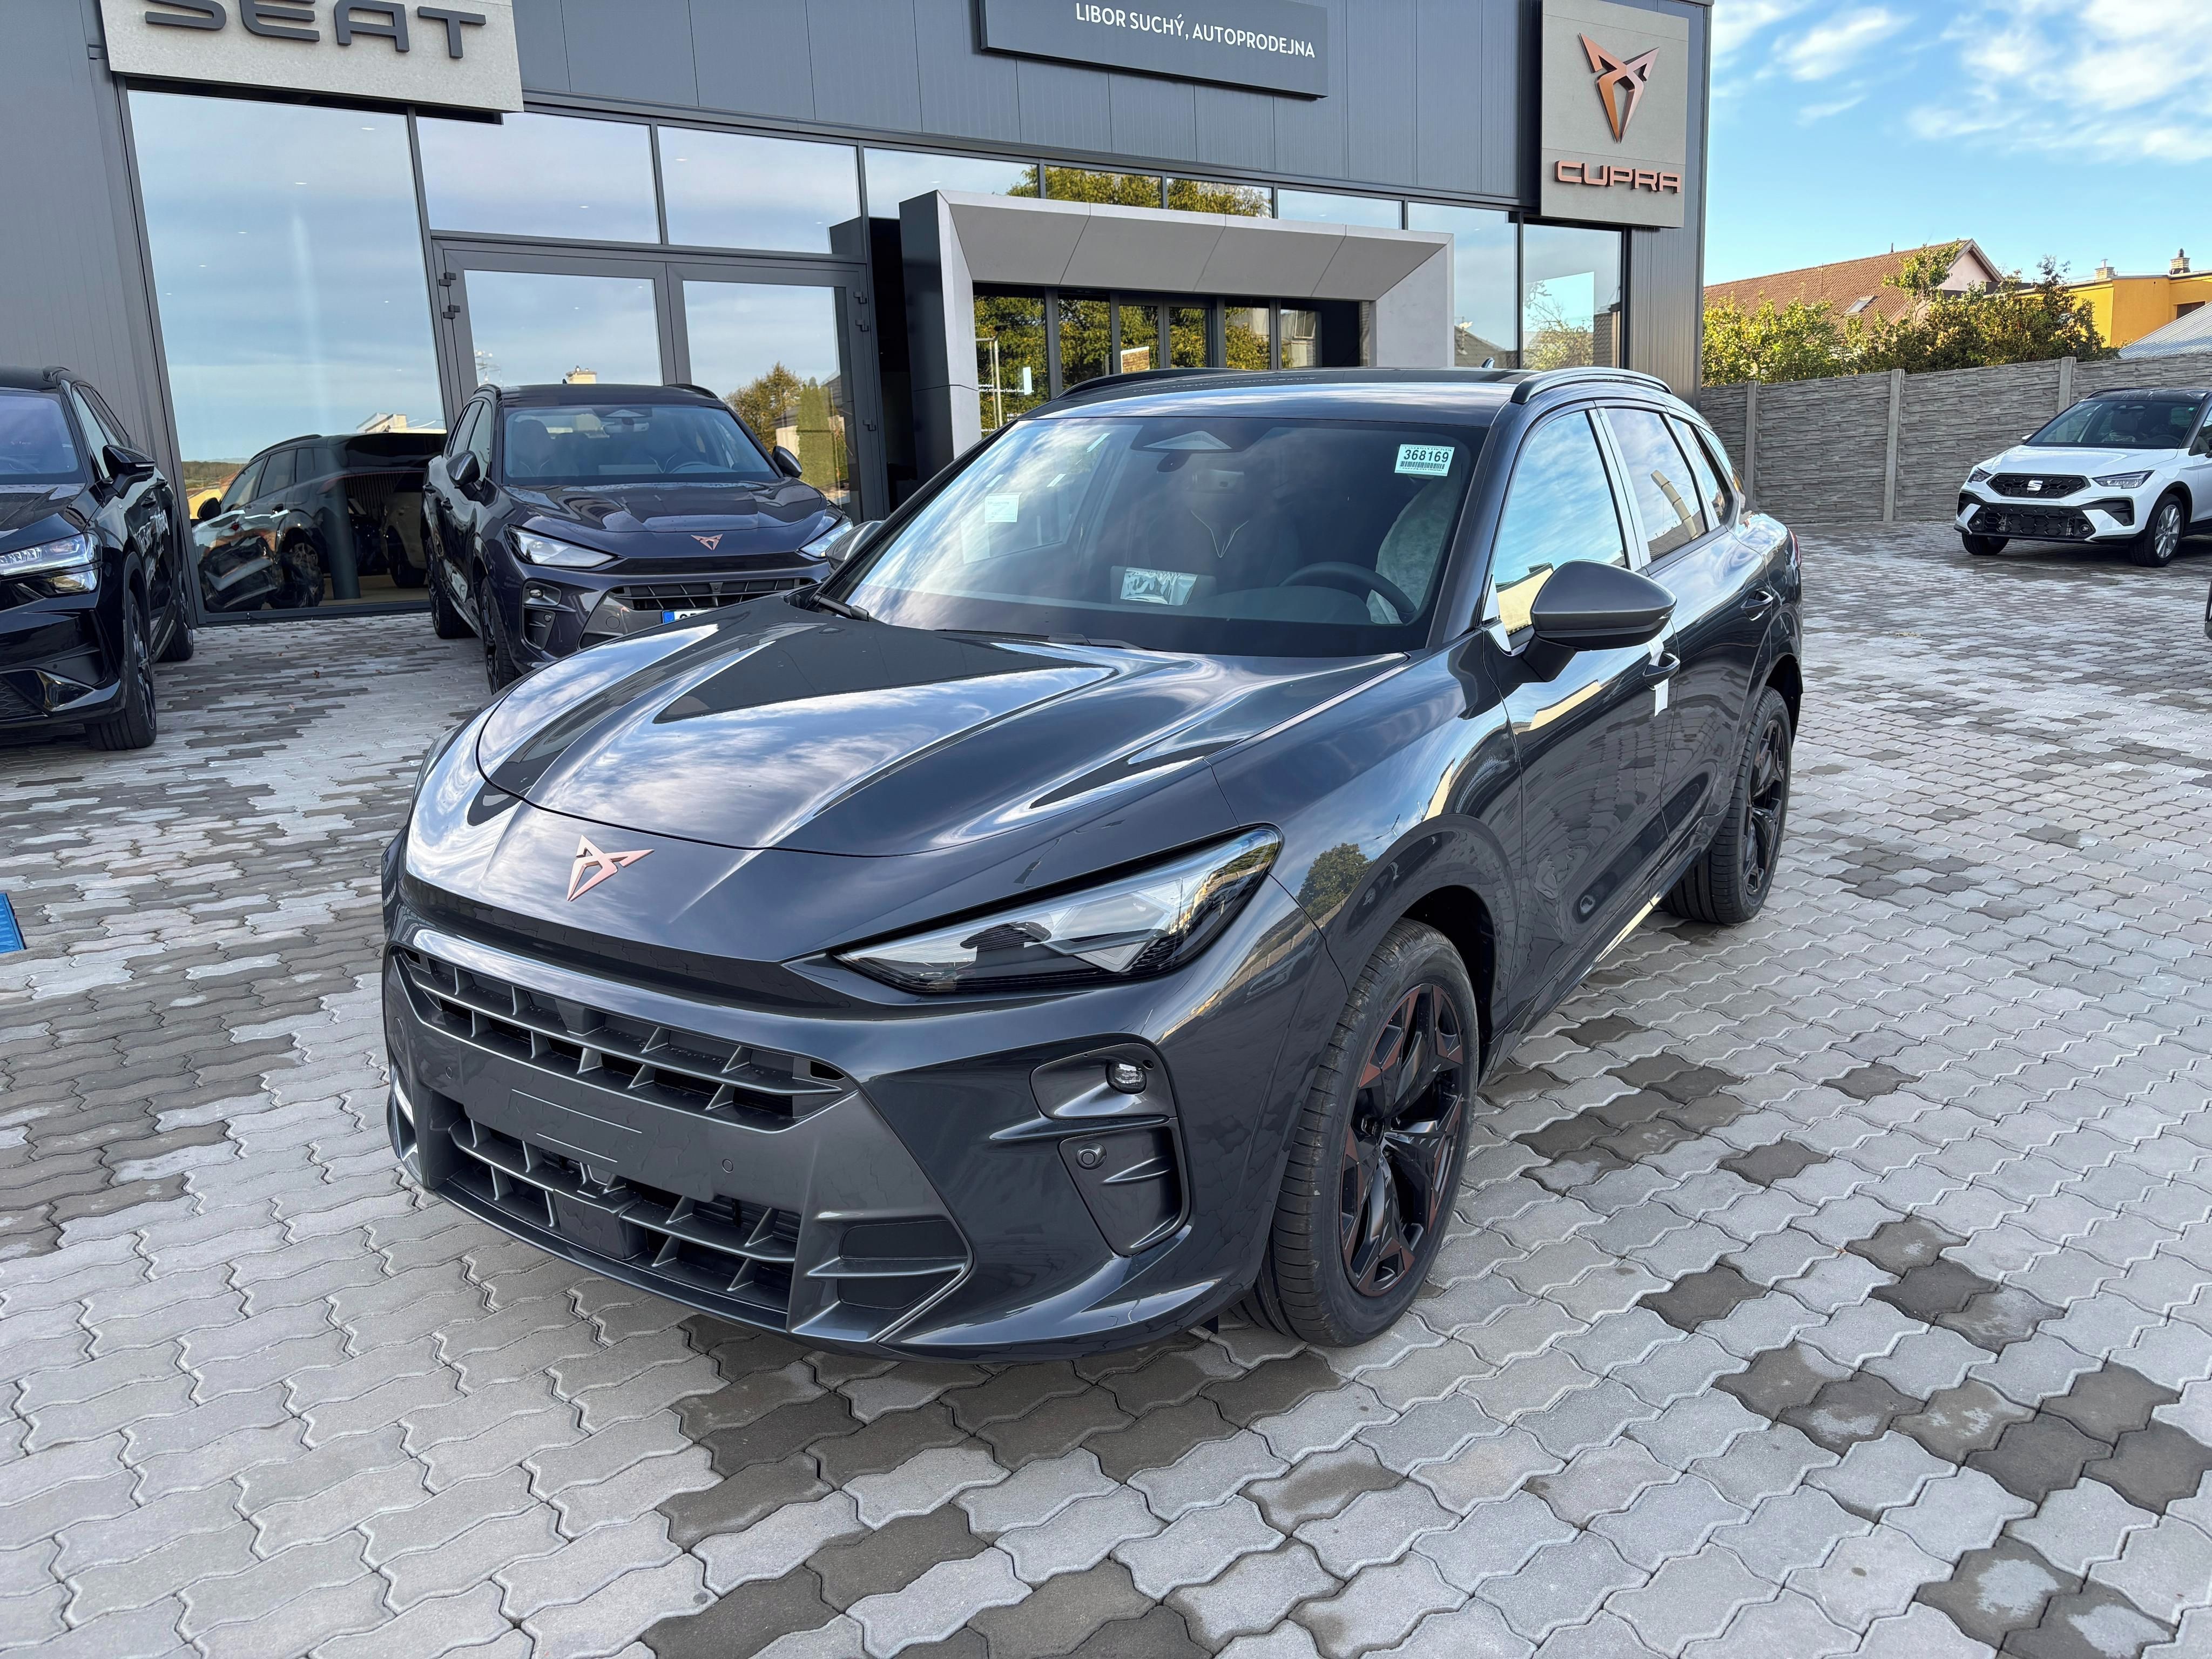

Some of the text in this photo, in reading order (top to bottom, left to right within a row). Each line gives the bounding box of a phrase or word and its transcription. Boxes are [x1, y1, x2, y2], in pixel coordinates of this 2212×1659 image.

[145, 0, 487, 59] SEAT
[1075, 2, 1316, 58] LIBOR SUCHÝ, AUTOPRODEJNA
[1554, 160, 1682, 194] CUPRA
[1404, 449, 1449, 463] 368169
